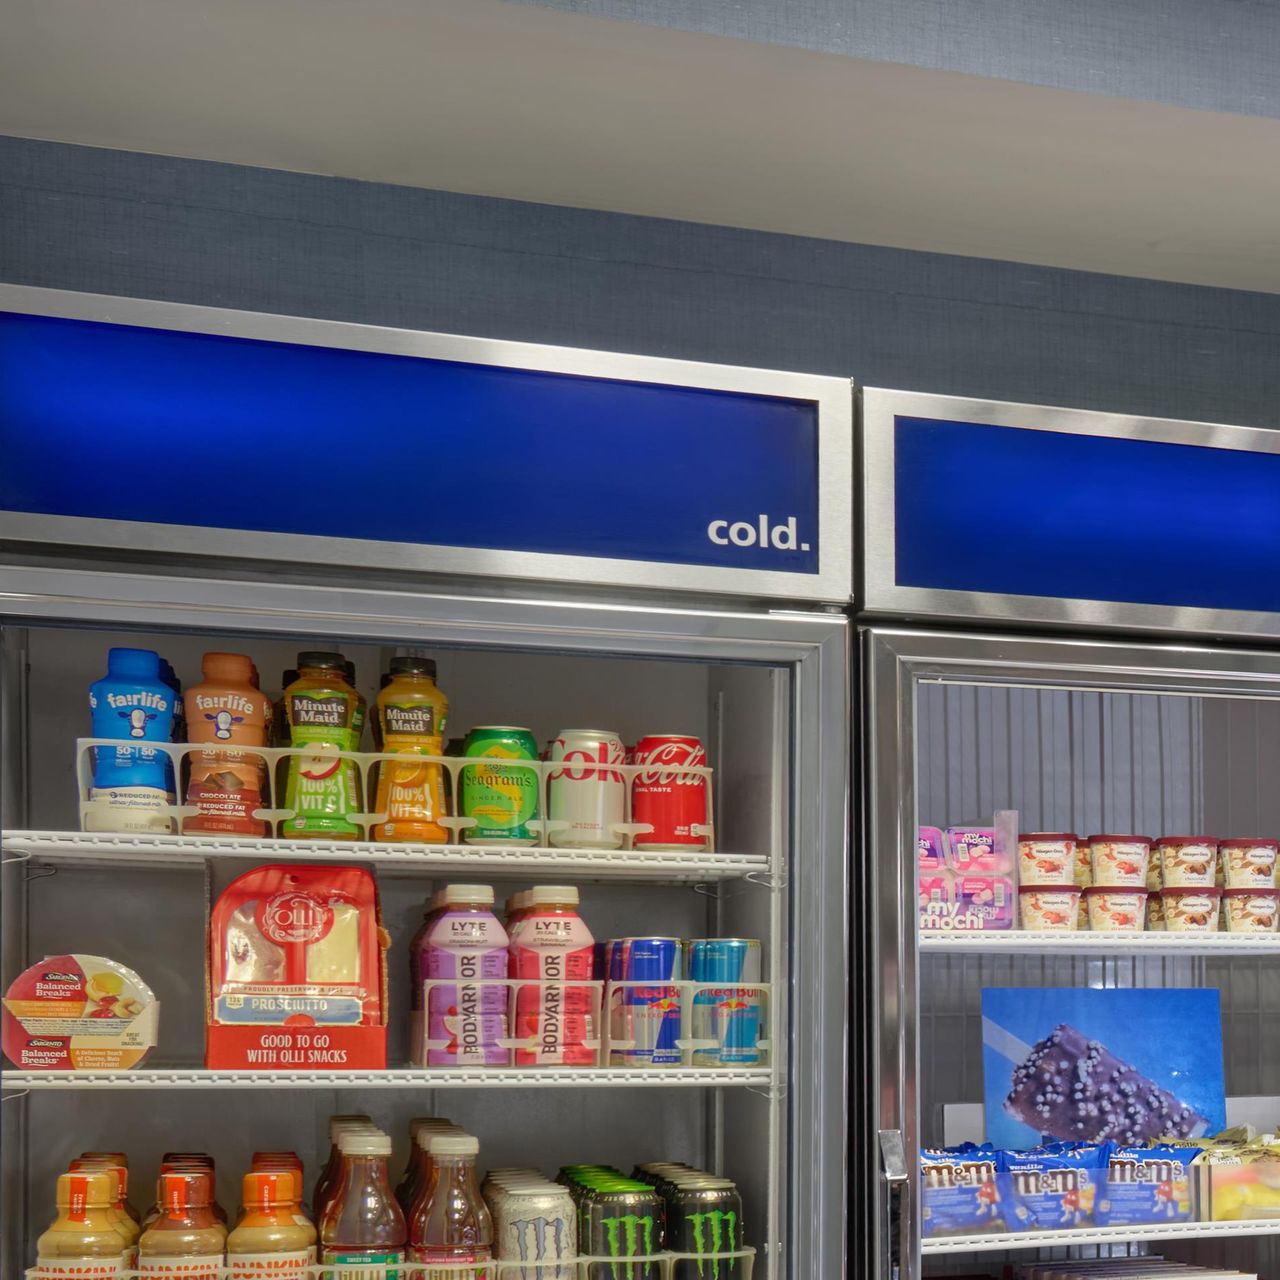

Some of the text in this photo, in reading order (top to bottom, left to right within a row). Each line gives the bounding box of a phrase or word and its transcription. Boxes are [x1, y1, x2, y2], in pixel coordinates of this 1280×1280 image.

[707, 517, 810, 552] cold.
[295, 699, 345, 713] Minute
[300, 711, 339, 724] Maid
[926, 902, 960, 919] my
[535, 921, 572, 931] LYTE
[920, 912, 984, 929] mochi
[252, 998, 328, 1011] PROSCIUTTO
[260, 1035, 329, 1048] GOOD TO GO
[21, 1050, 68, 1059] Balanced
[247, 1049, 347, 1063] WITH OLLI SNACKS
[21, 1057, 58, 1066] Breaks
